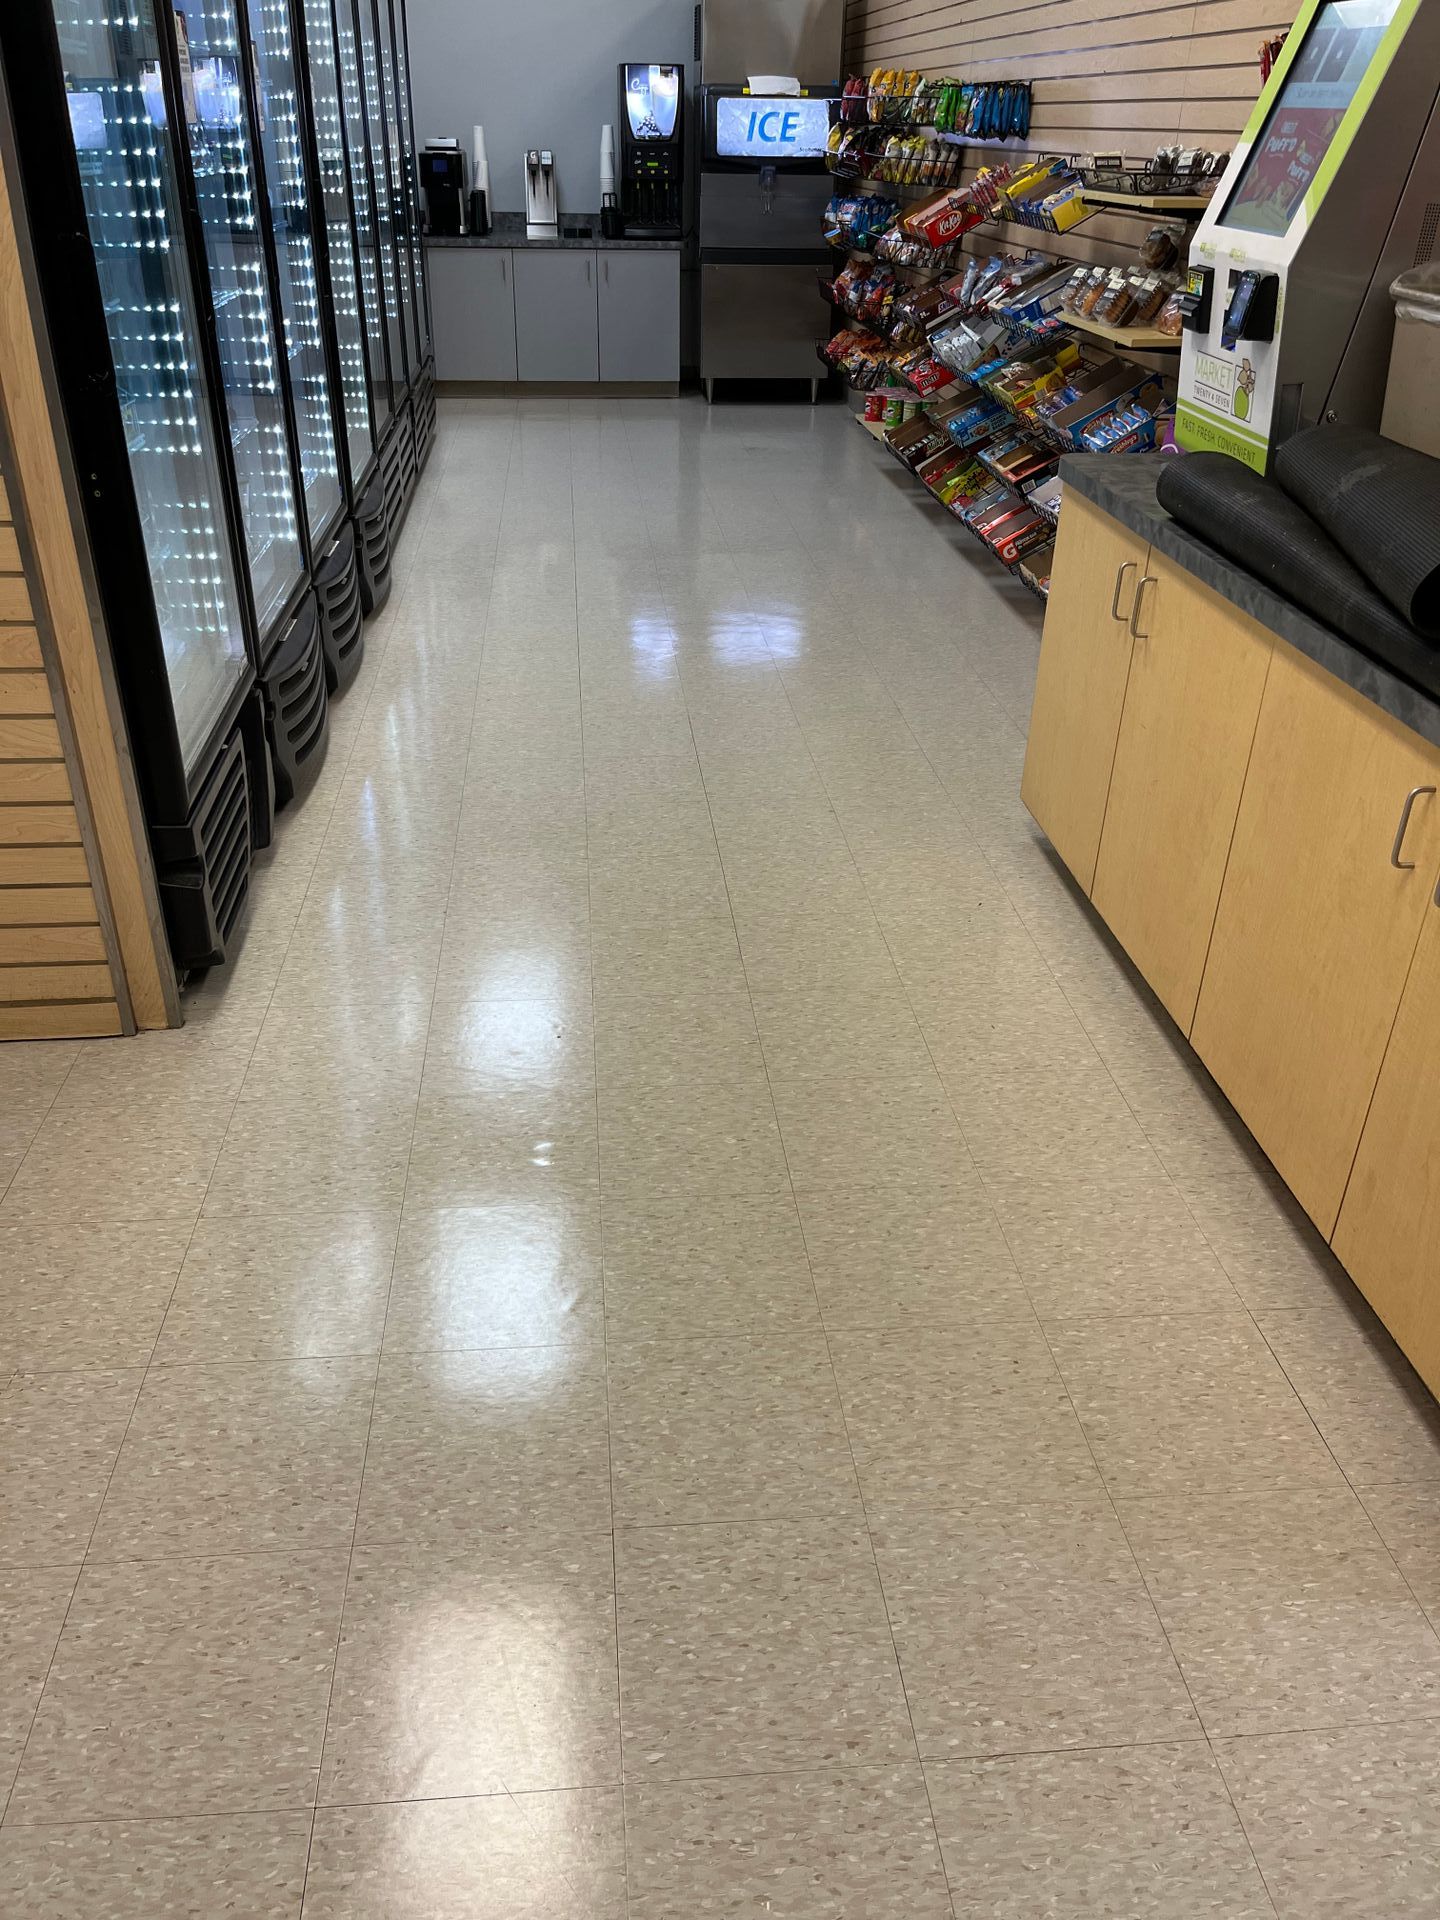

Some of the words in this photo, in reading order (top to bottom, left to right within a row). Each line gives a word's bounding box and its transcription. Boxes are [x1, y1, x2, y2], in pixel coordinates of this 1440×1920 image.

[746, 111, 800, 142] ICE
[1195, 355, 1232, 389] MARKET
[1194, 385, 1210, 399] TWENTY
[1215, 394, 1230, 408] SEVEN
[1003, 543, 1017, 558] G
